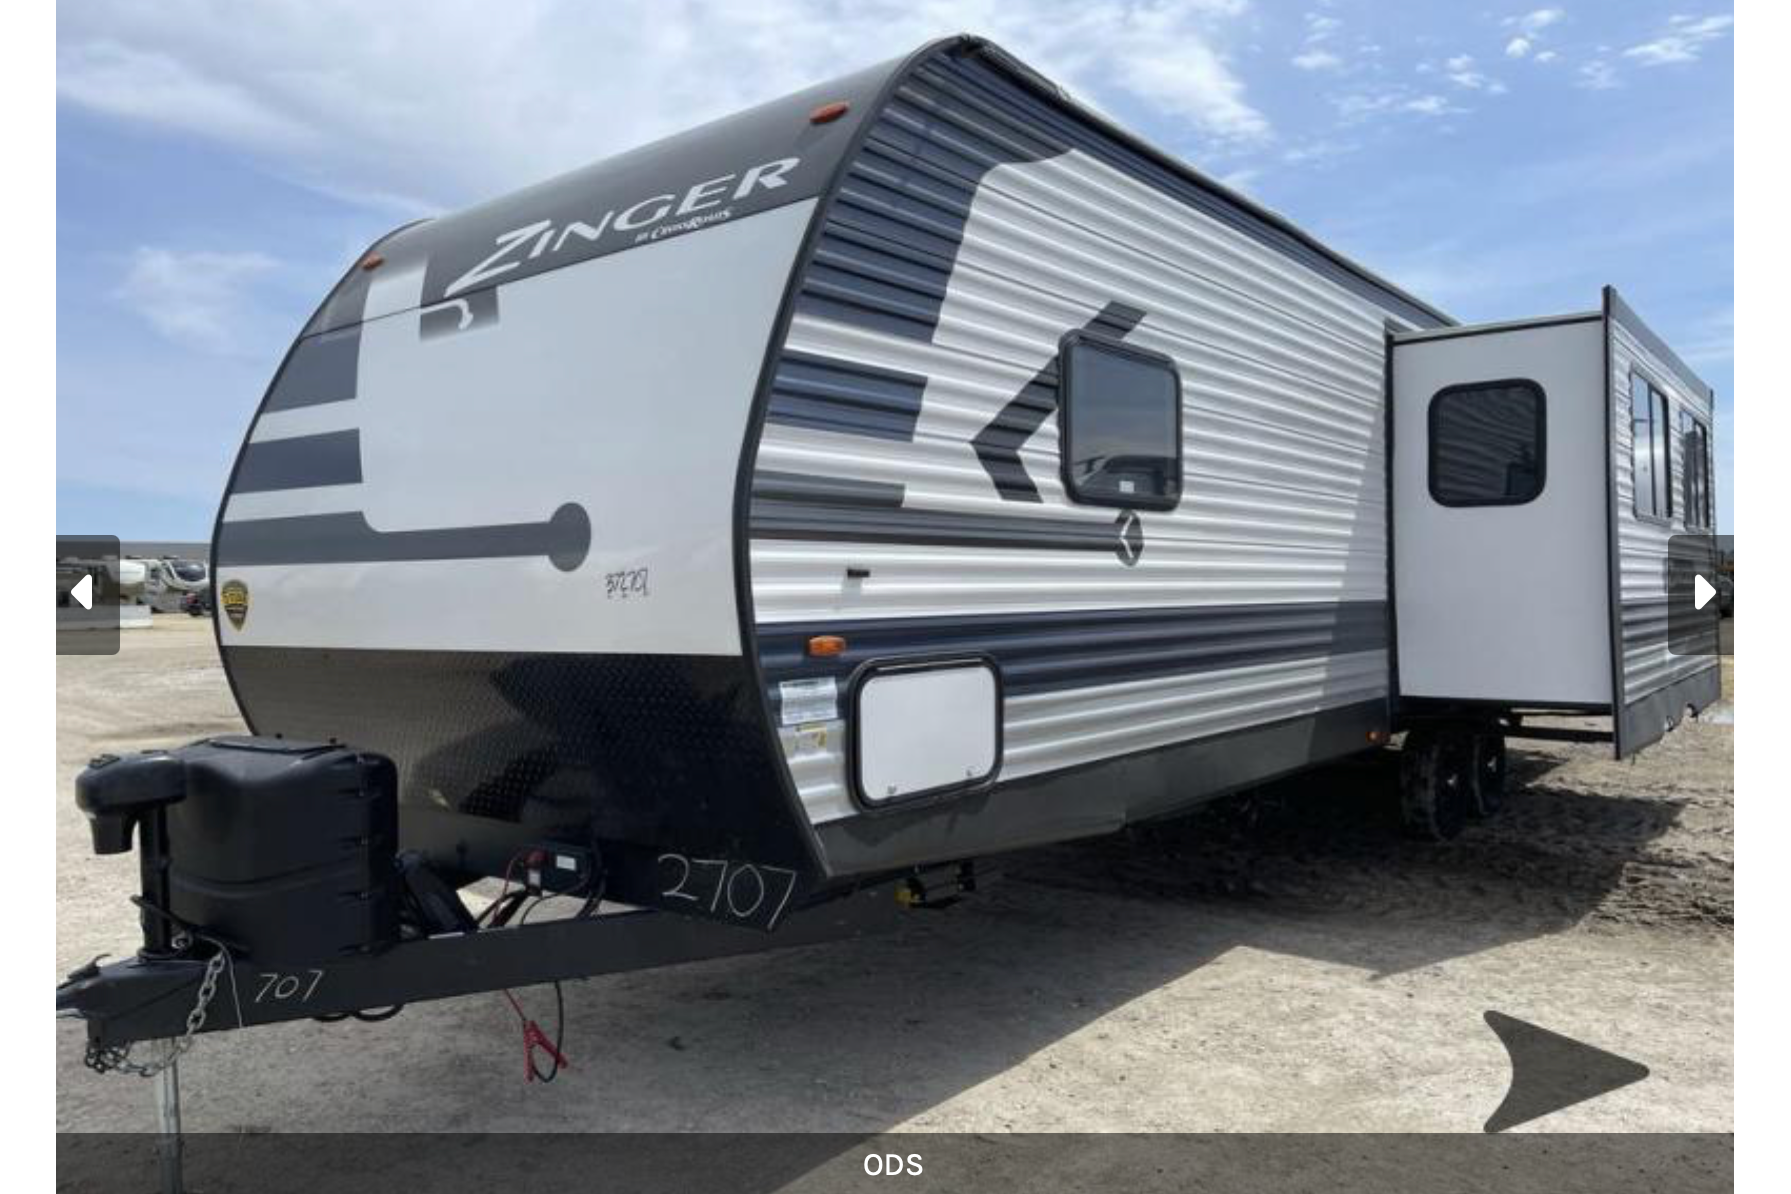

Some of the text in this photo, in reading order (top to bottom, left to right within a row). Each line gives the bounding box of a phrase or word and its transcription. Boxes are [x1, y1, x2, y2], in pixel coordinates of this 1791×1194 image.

[444, 157, 800, 298] ZINGER
[658, 853, 796, 930] 2707
[255, 969, 324, 1003] 707
